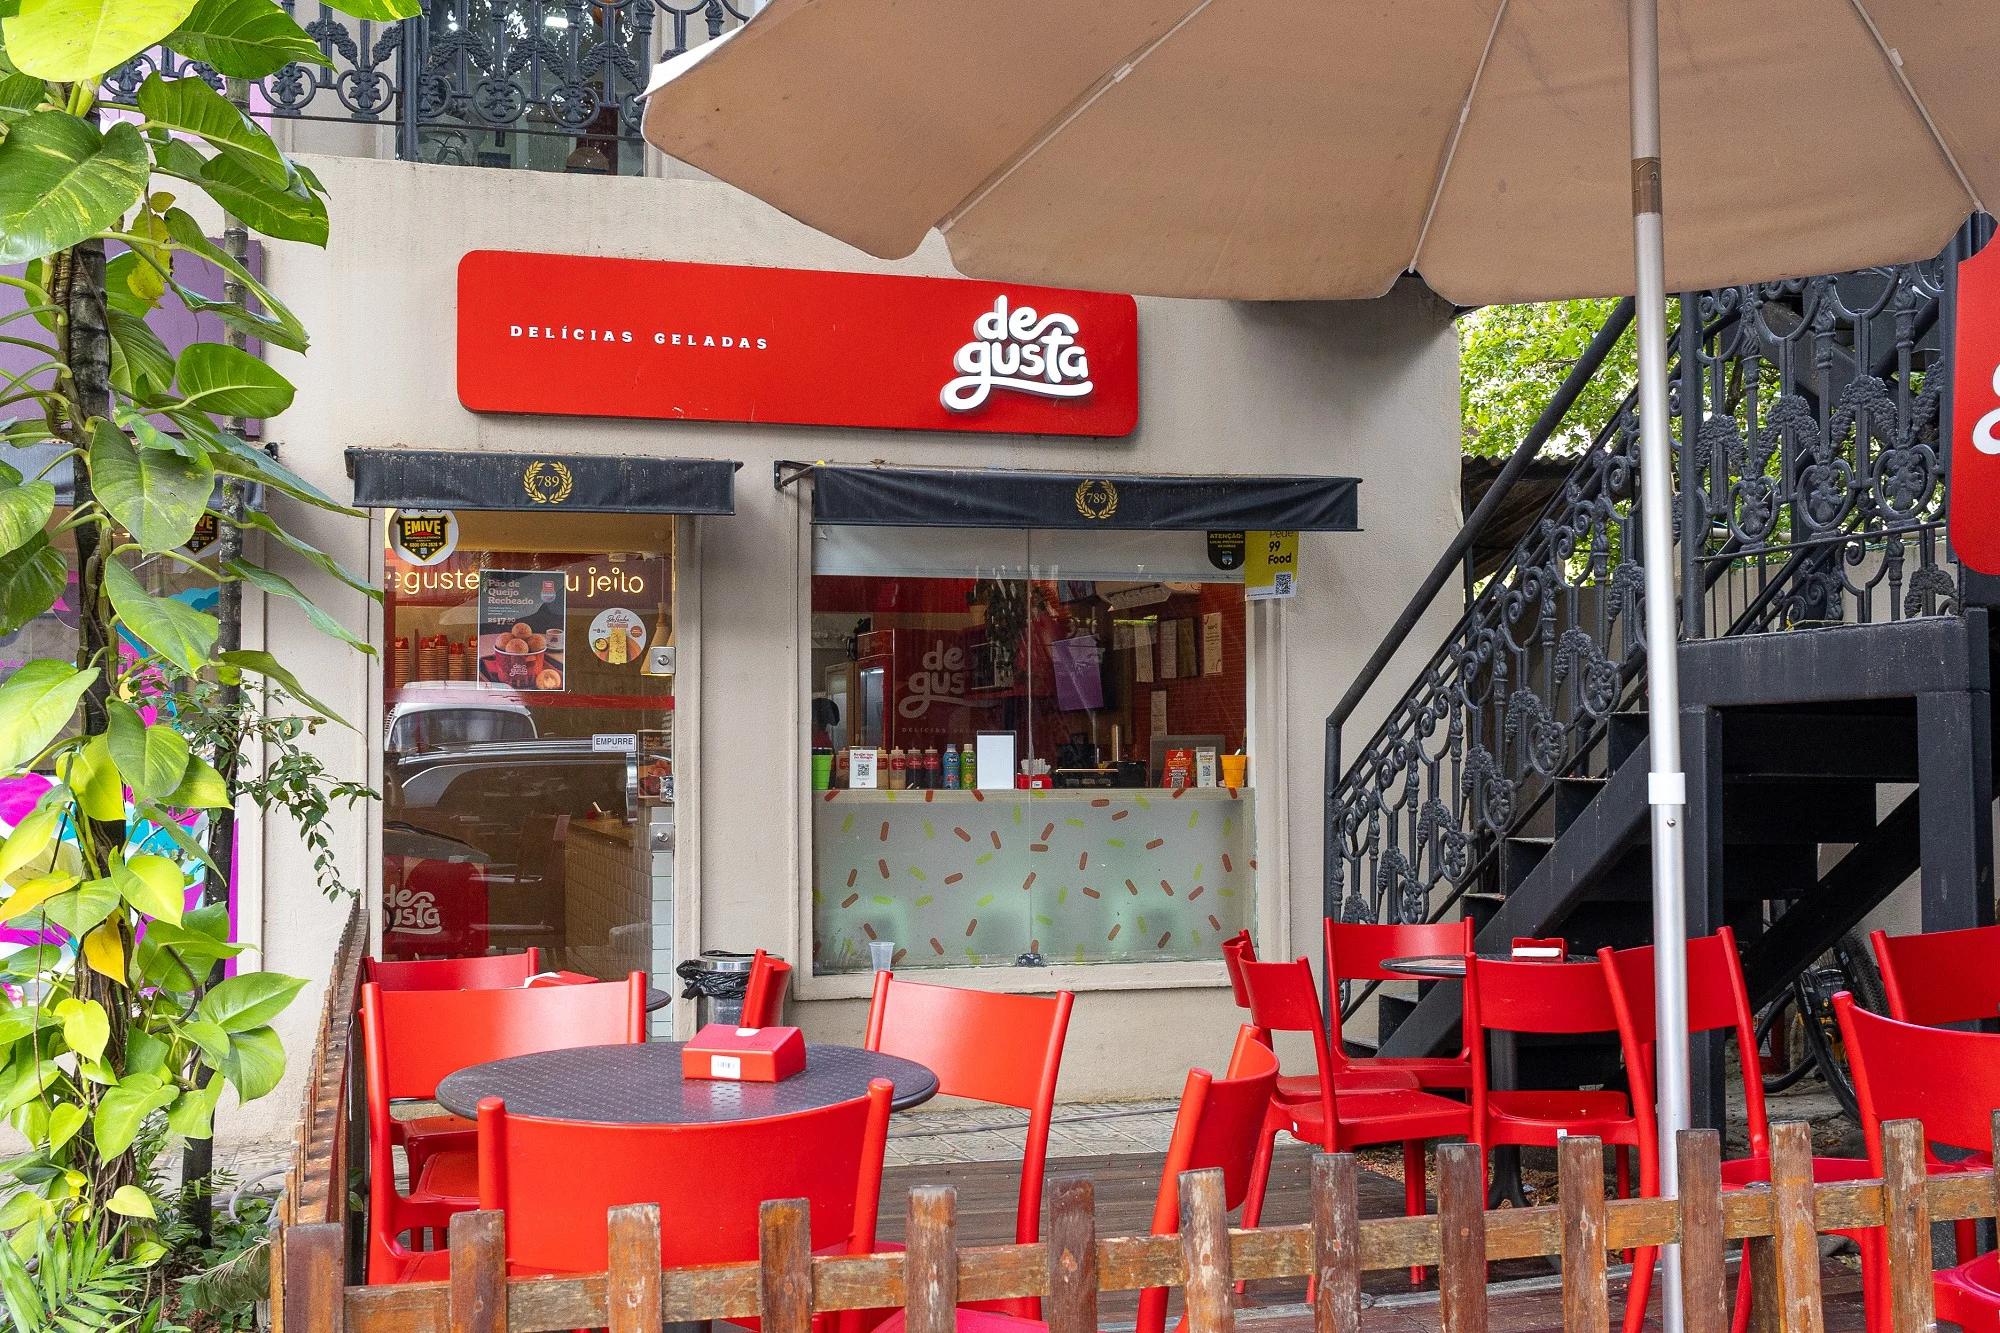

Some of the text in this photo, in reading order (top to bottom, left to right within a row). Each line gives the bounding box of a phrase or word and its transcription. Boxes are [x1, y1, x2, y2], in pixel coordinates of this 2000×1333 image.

[973, 294, 1079, 341] de
[510, 325, 767, 350] DELÍCIAS GELADAS
[940, 327, 1094, 411] gusta
[536, 475, 560, 488] 789
[1086, 492, 1107, 504] 789
[404, 520, 441, 536] EMIVE
[1269, 541, 1281, 552] 99
[1268, 553, 1292, 564] Food
[394, 568, 480, 595] eguste
[587, 567, 644, 598] jeito
[488, 588, 519, 597] Queijo
[488, 596, 534, 605] Recheado
[923, 639, 964, 671] de
[595, 737, 634, 746] EMPURRE
[383, 884, 435, 907] de
[383, 898, 442, 934] usta
